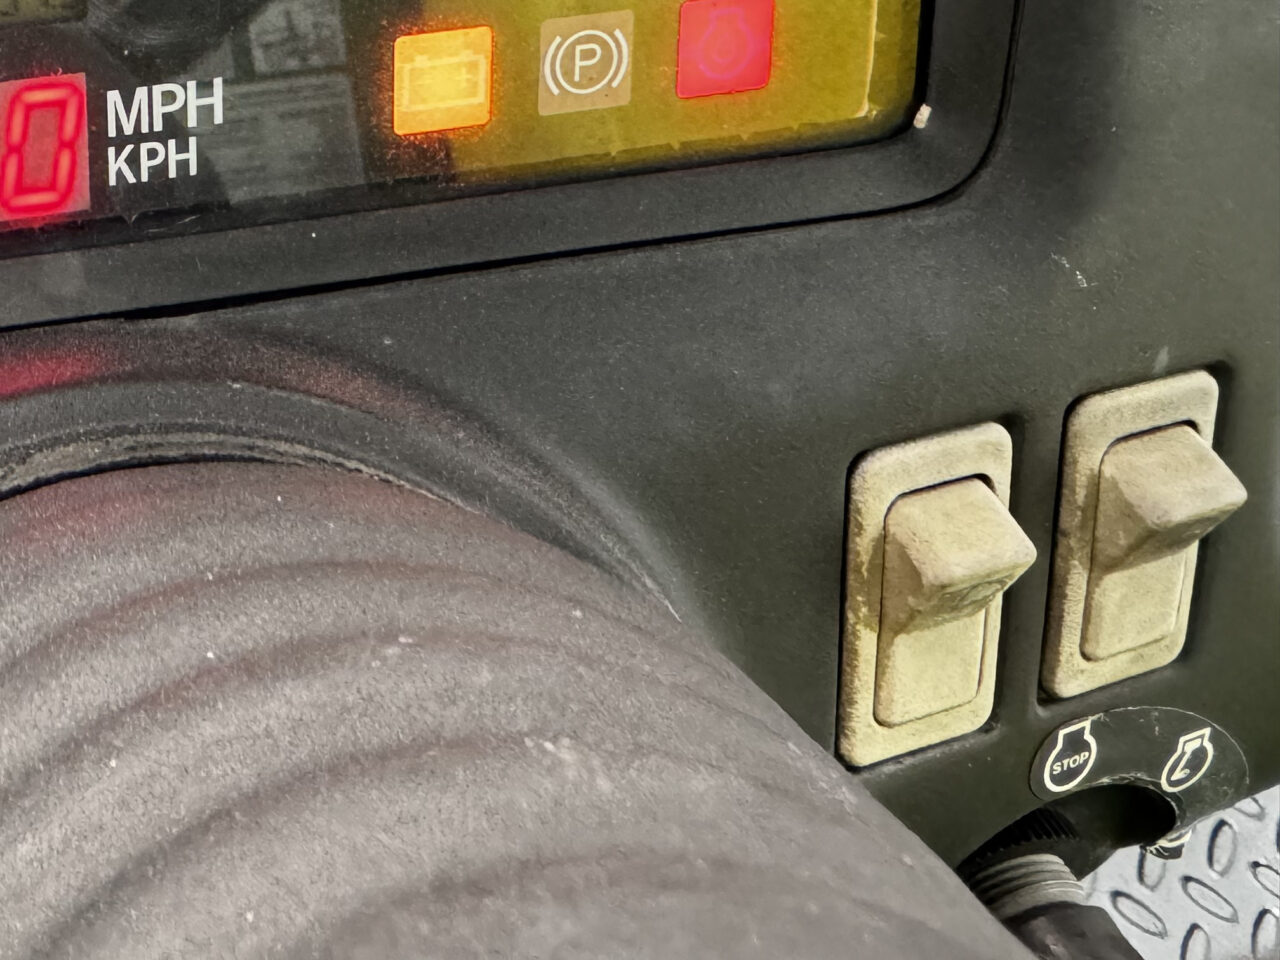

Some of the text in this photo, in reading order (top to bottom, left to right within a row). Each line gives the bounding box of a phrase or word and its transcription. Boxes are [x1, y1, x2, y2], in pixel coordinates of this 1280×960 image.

[574, 43, 602, 82] P
[106, 77, 224, 138] MPH
[107, 137, 198, 187] KPH
[1052, 752, 1089, 774] STOP
